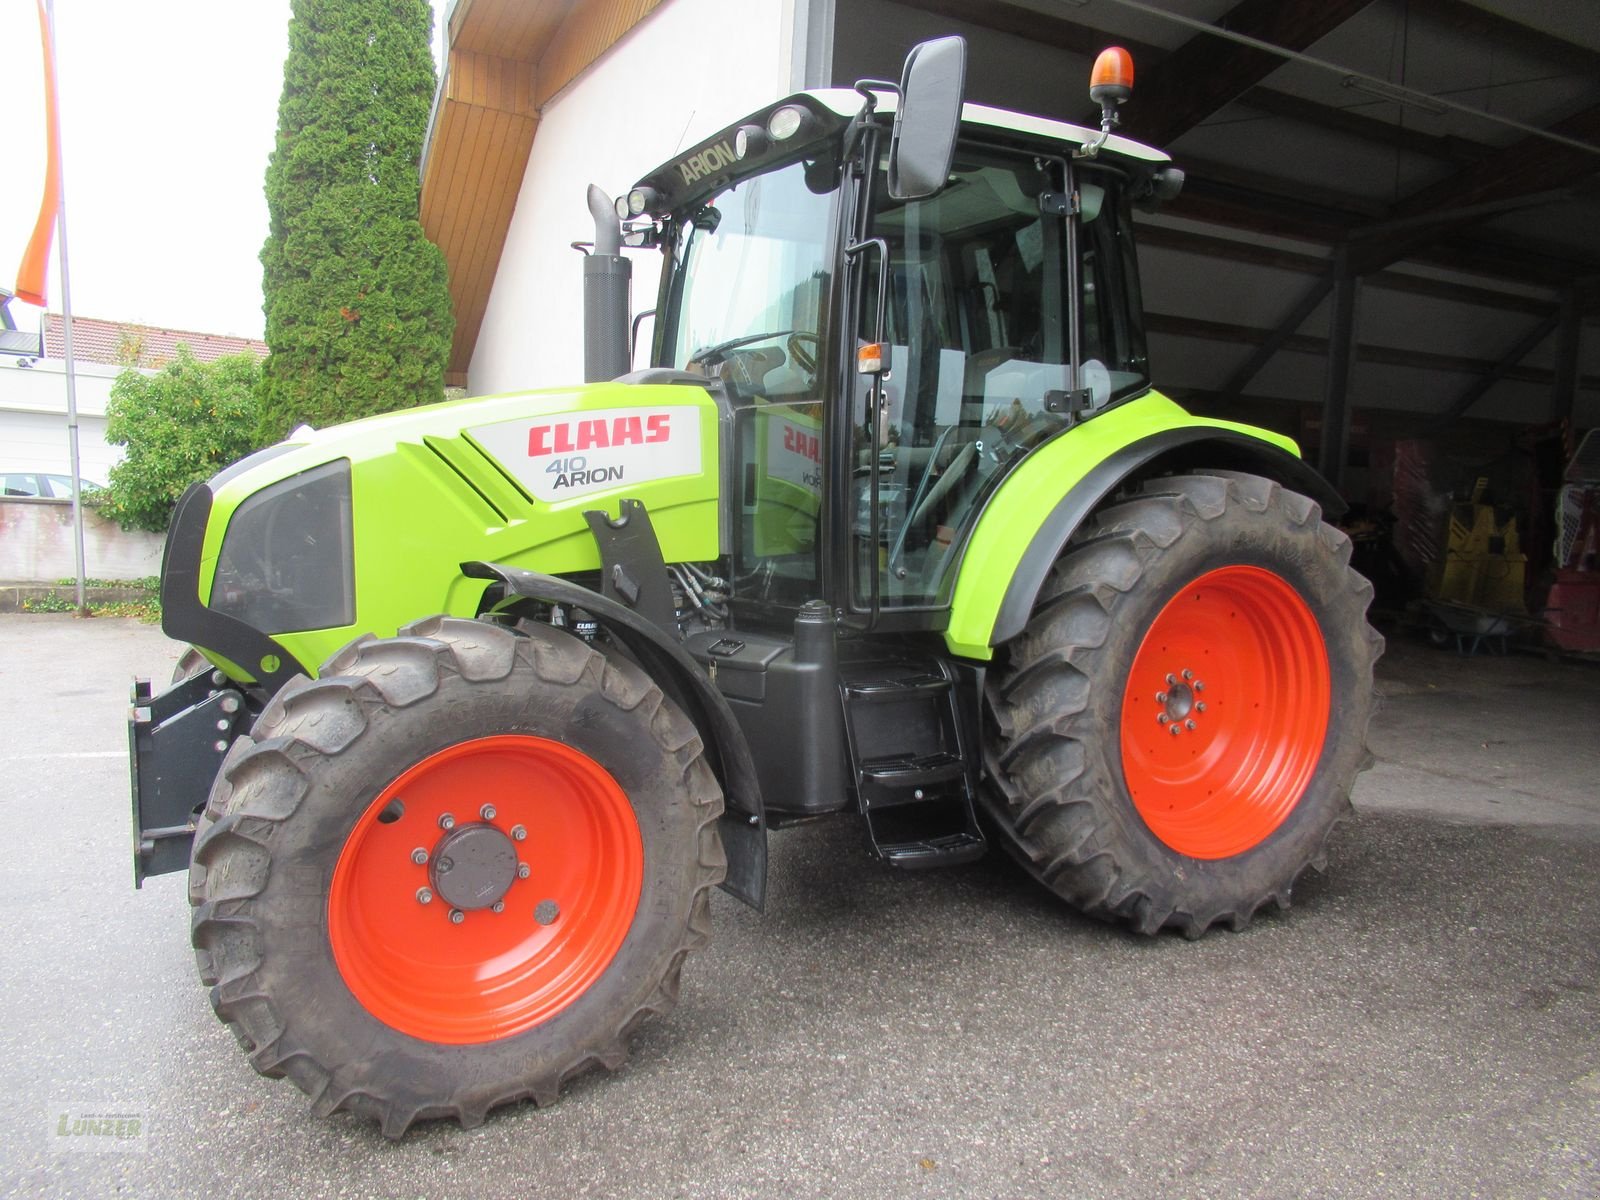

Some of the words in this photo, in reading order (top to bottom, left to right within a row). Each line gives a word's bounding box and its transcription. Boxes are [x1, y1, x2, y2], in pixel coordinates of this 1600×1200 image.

[680, 140, 737, 186] ARION
[528, 414, 670, 457] CLAAS
[545, 456, 587, 474] 410
[553, 465, 624, 490] ARION
